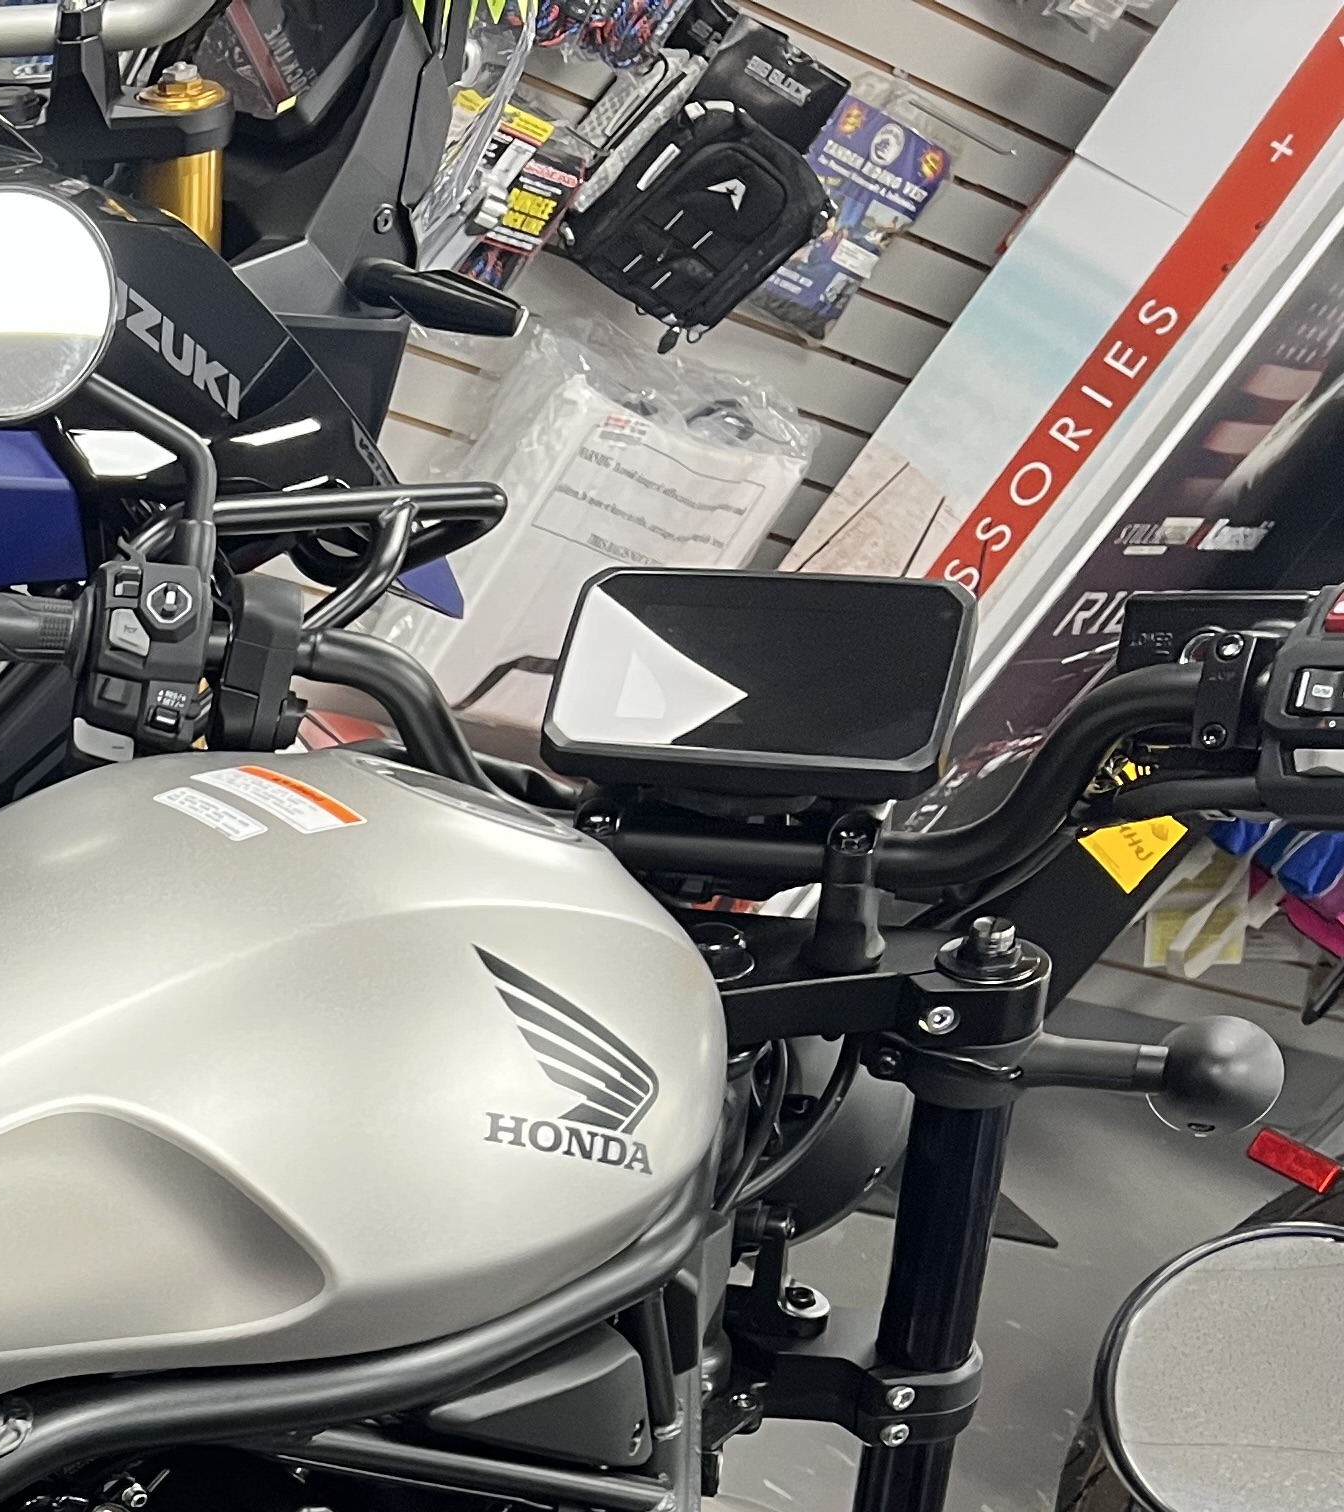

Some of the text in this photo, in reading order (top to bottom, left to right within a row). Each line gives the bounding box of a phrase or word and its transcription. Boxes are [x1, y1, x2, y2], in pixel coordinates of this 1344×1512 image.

[116, 277, 241, 420] ZUKI
[943, 298, 1179, 599] SSORIES
[483, 1111, 653, 1176] HONDA
